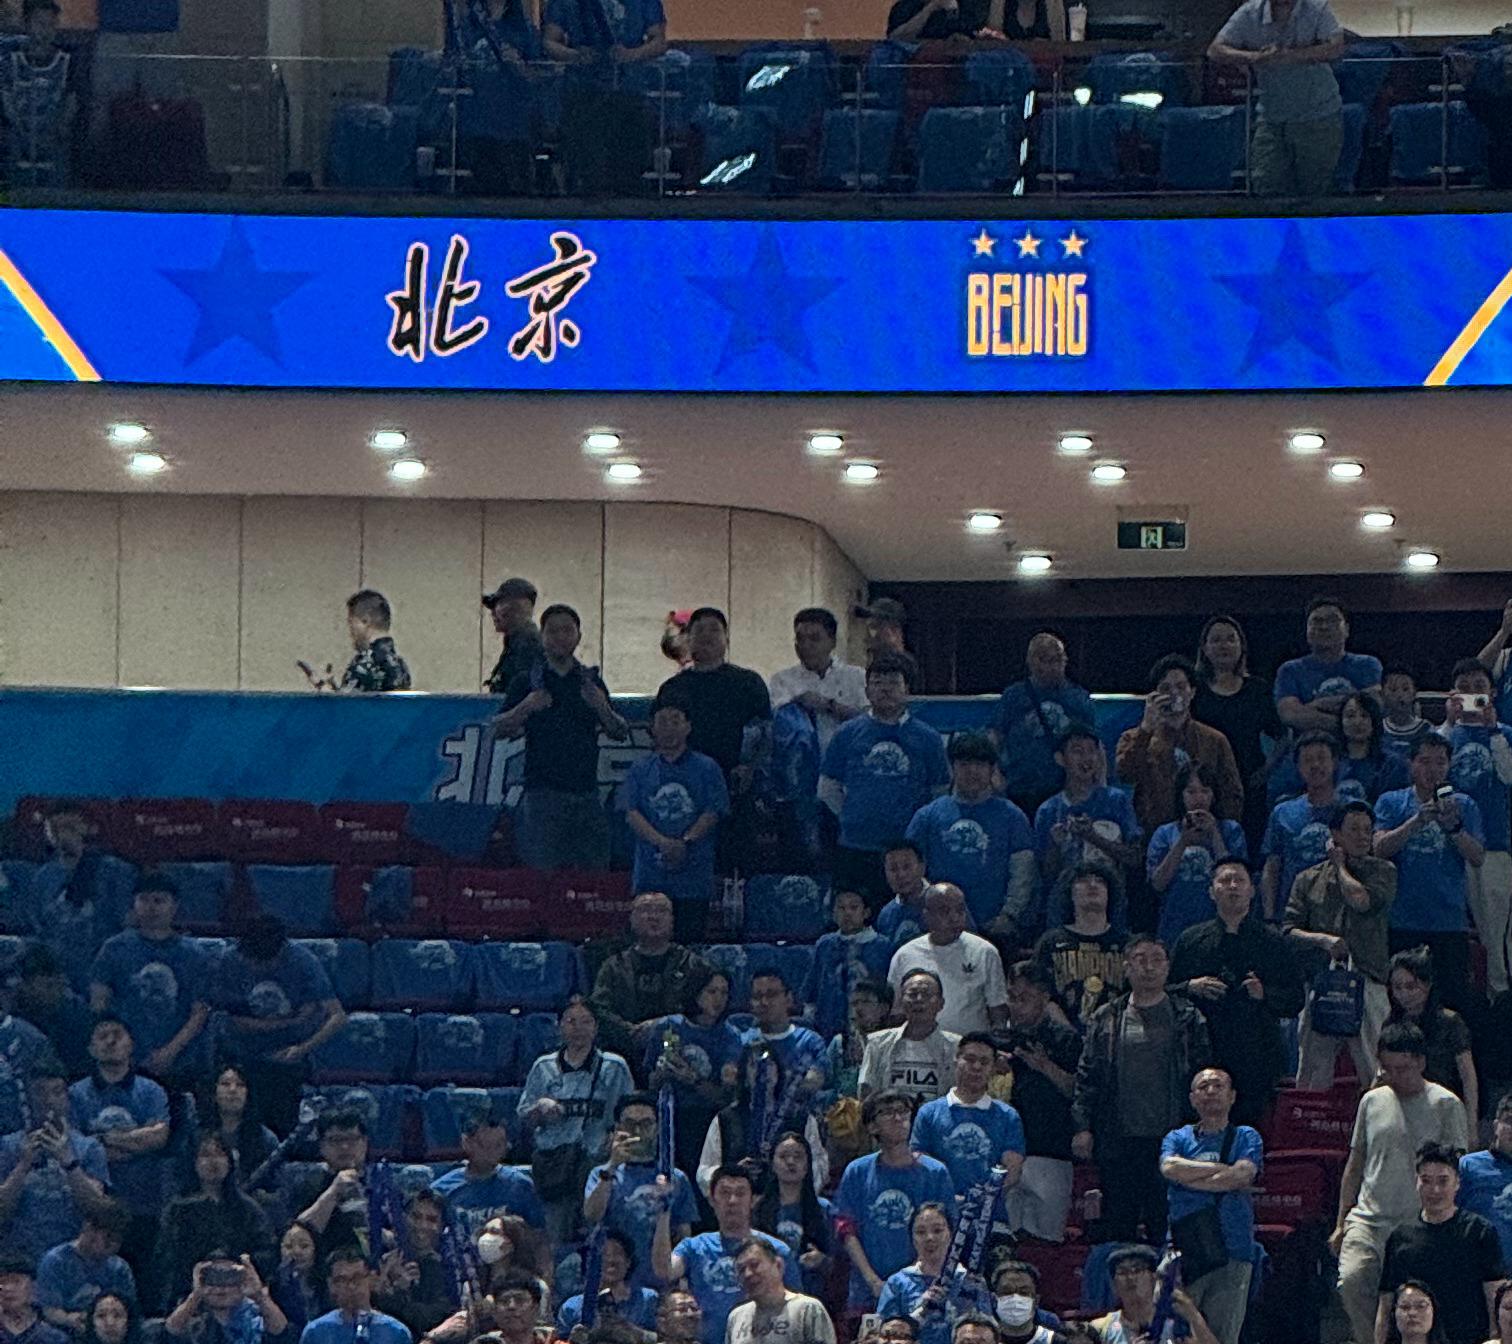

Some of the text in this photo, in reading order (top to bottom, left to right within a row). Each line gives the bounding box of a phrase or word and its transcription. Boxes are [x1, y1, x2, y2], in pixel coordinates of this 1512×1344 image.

[387, 230, 598, 362] 北京
[967, 272, 1089, 357] BEIJING
[891, 1069, 938, 1086] FILA
